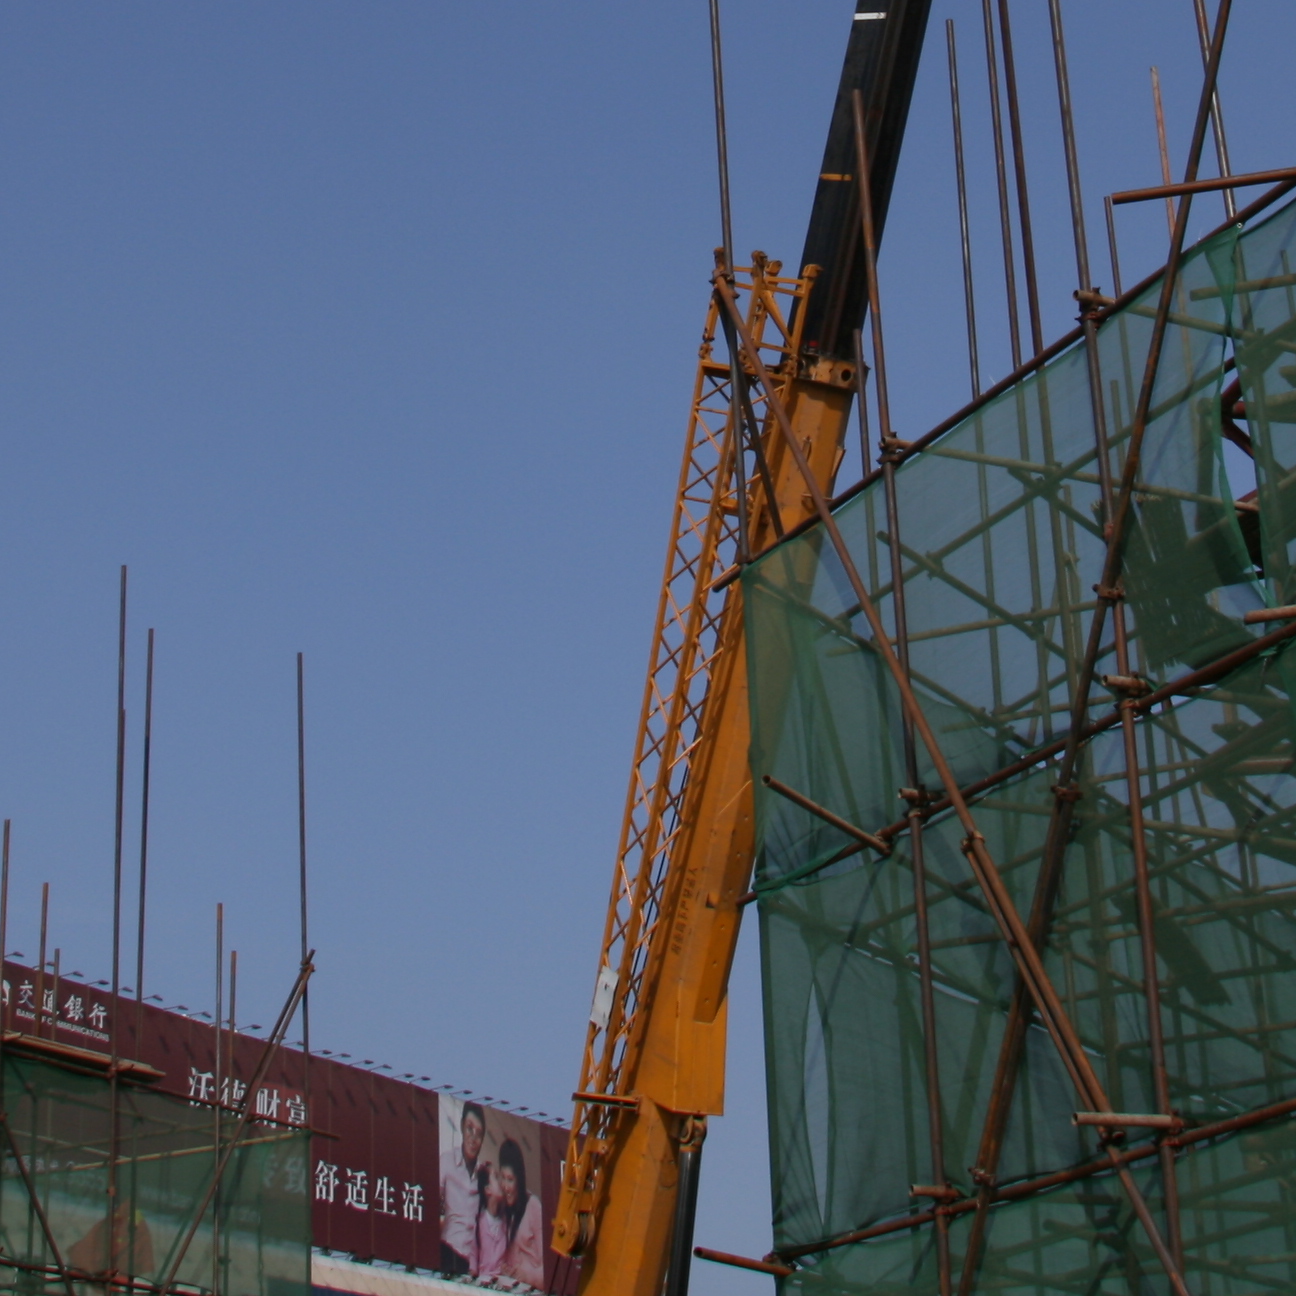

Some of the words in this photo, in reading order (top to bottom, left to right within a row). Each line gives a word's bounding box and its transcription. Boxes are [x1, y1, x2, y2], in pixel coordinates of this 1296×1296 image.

[15, 1008, 36, 1020] BANK
[188, 1066, 306, 1131] 沃德财富
[314, 1160, 425, 1223] 舒适生活
